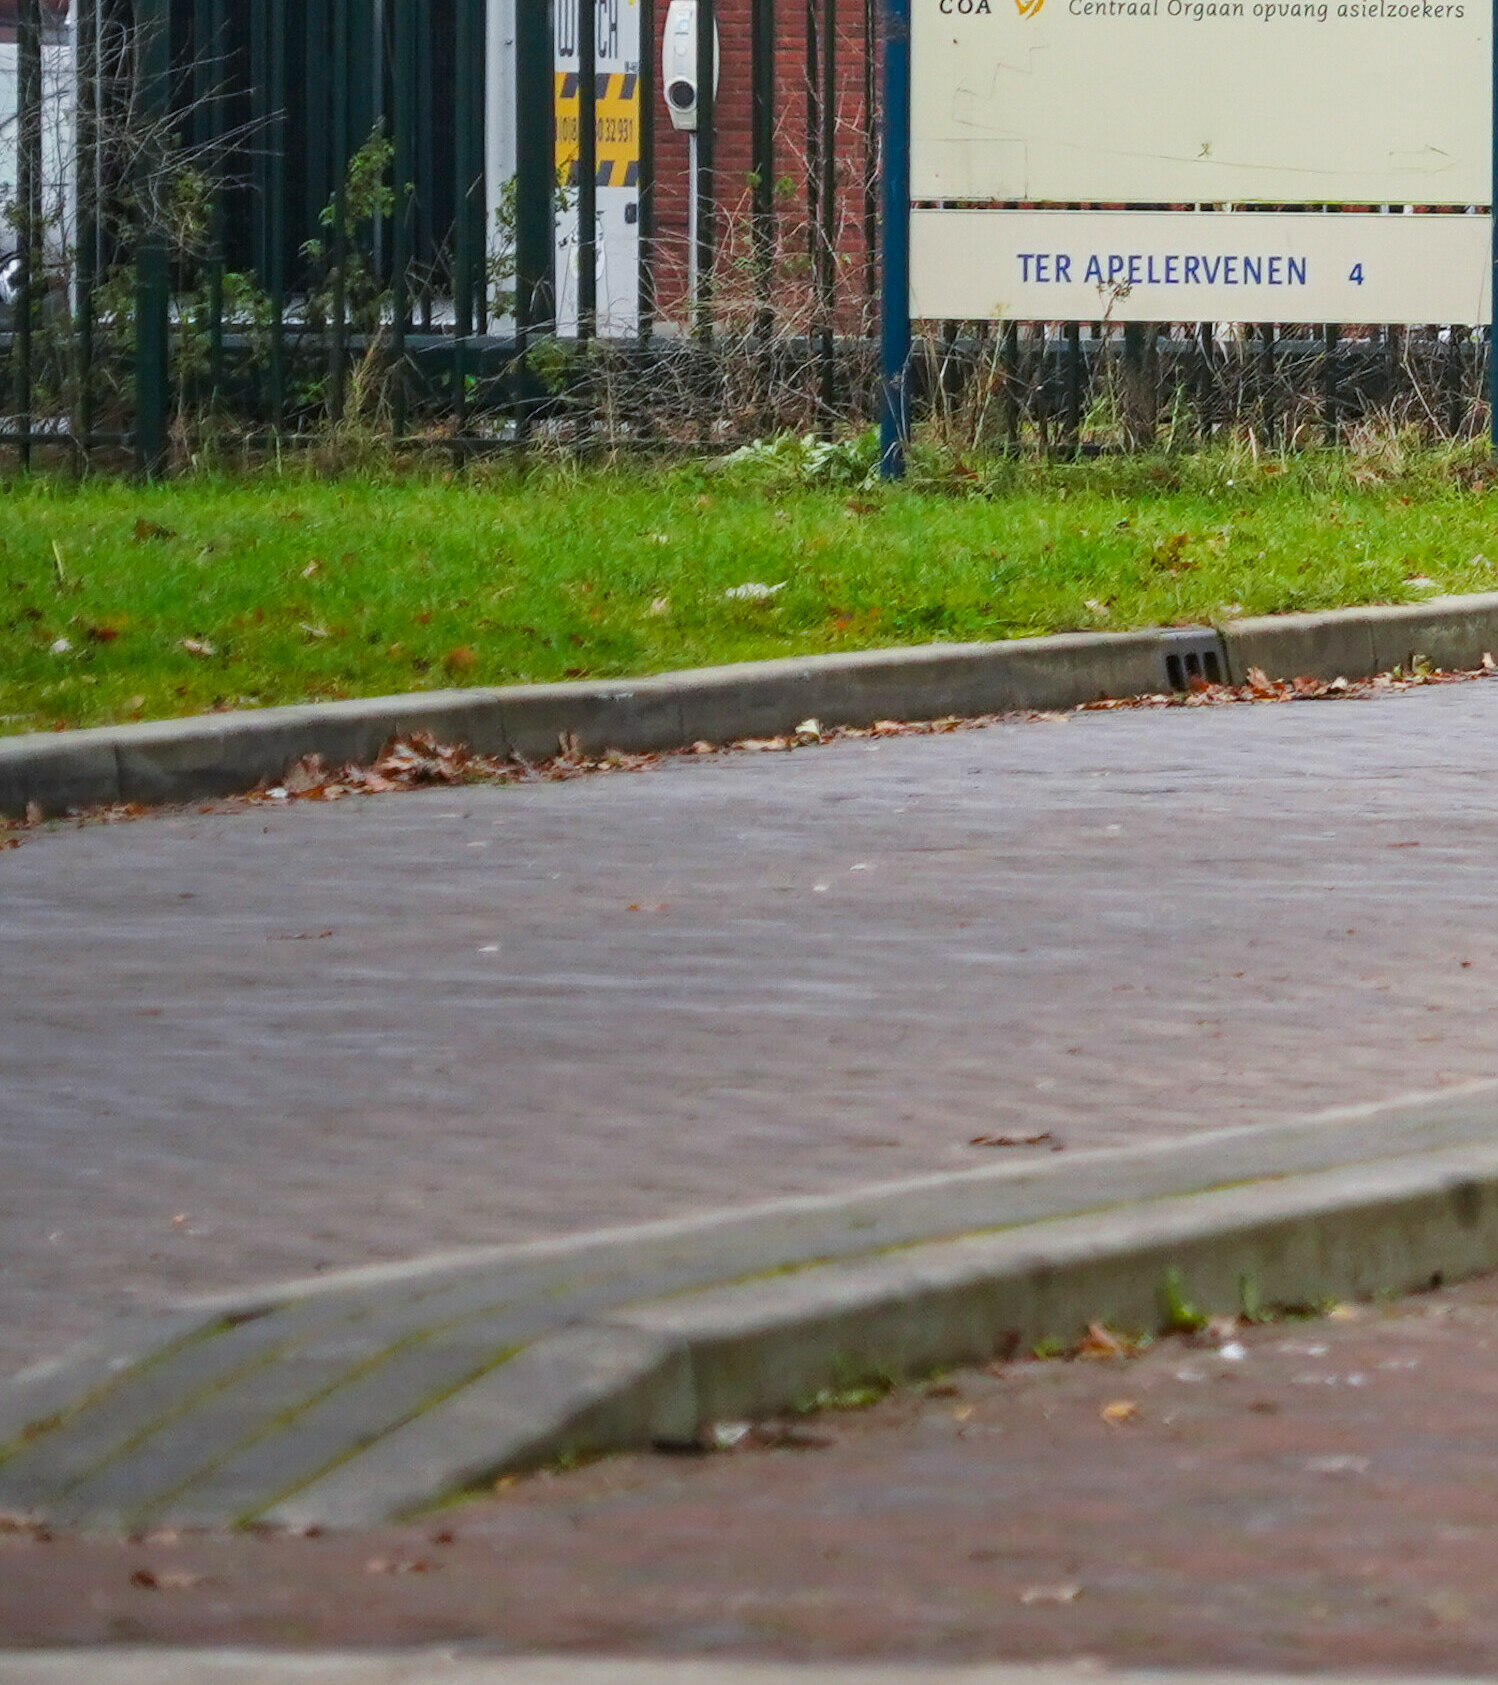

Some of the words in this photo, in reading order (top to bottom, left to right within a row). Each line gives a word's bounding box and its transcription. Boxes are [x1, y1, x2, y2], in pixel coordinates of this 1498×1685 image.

[1252, 2, 1328, 23] opvang
[1016, 253, 1073, 283] TER
[1083, 253, 1307, 286] APELERVENEN
[1348, 263, 1366, 286] 4
